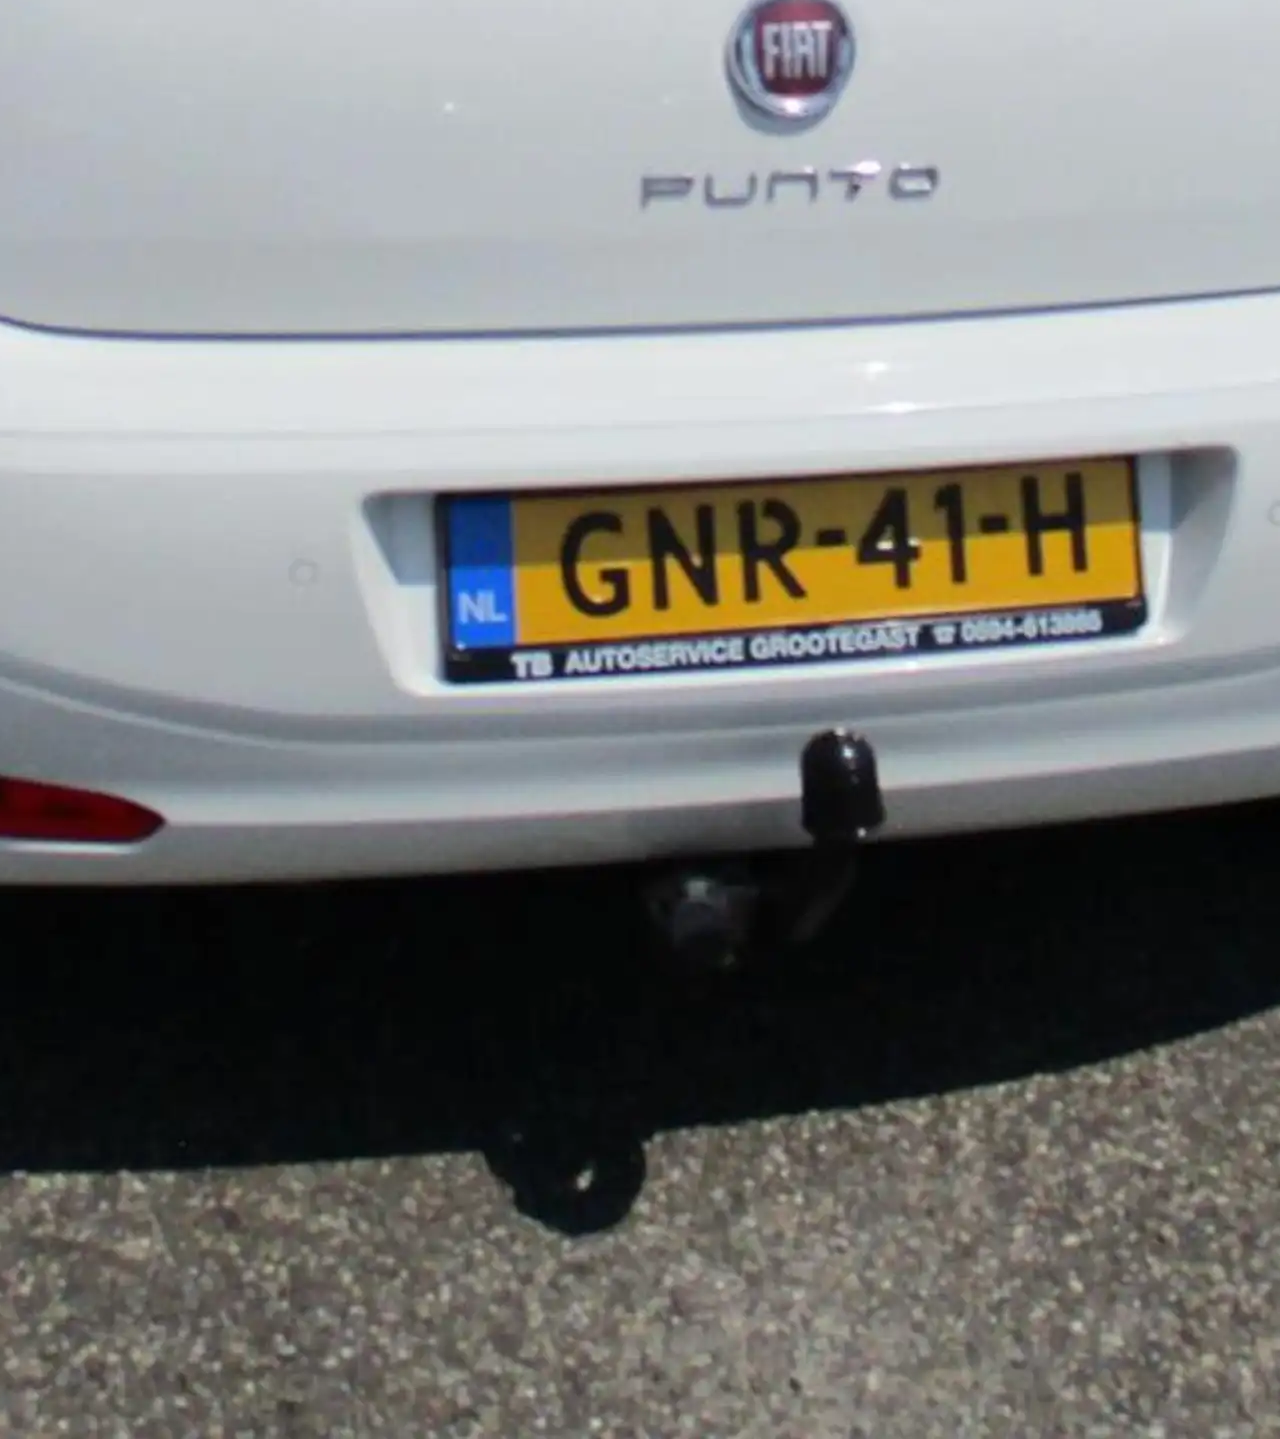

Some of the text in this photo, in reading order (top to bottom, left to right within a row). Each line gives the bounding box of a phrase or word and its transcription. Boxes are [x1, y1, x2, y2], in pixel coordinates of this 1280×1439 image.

[762, 20, 832, 80] FIAT
[639, 162, 939, 210] PUNTO
[561, 471, 1090, 618] GNR-41-H
[457, 591, 506, 624] NL
[511, 651, 553, 678] TB
[565, 637, 745, 674] AUTOSERVICE
[750, 623, 922, 660] GROOTEGAST
